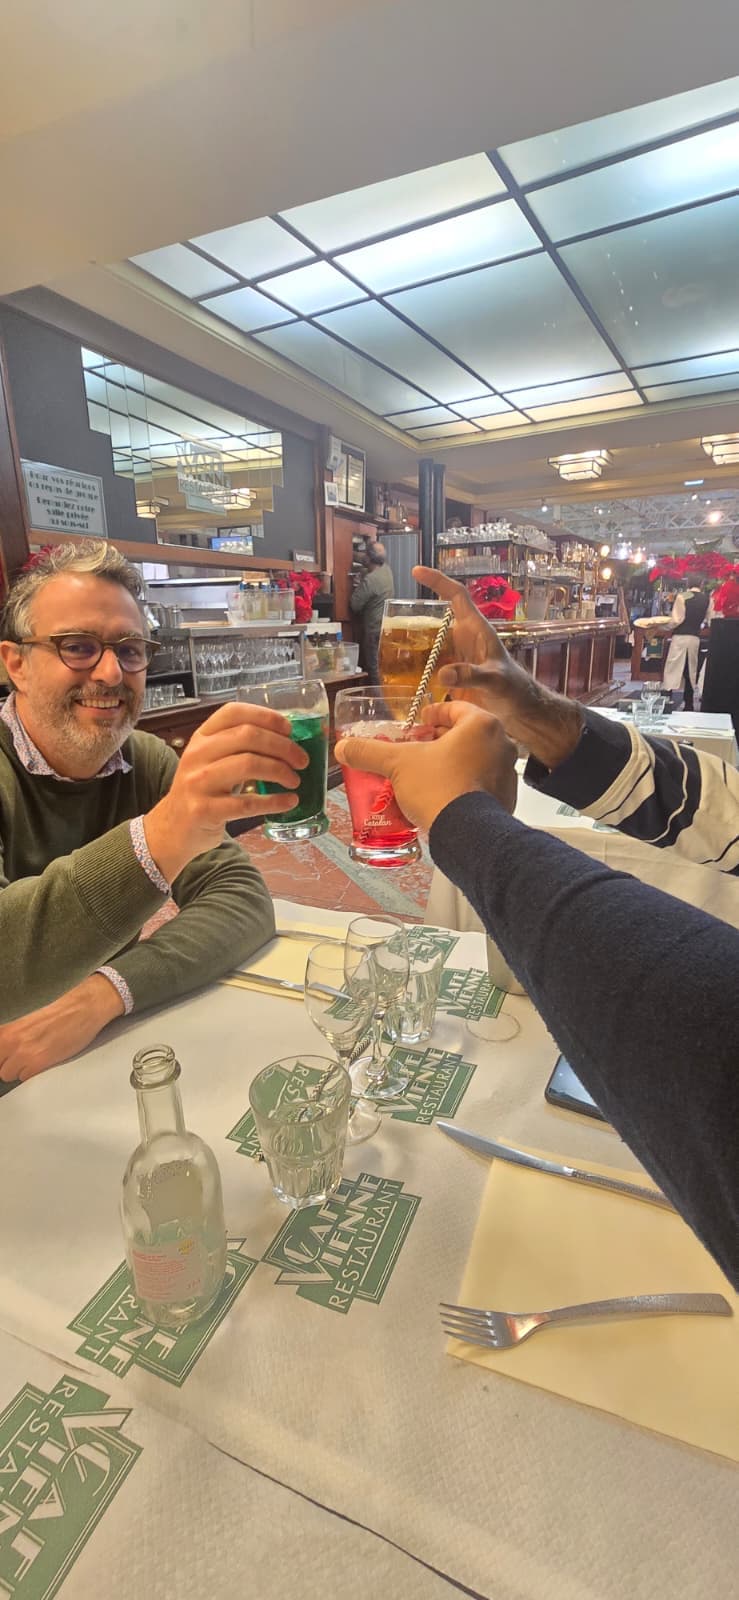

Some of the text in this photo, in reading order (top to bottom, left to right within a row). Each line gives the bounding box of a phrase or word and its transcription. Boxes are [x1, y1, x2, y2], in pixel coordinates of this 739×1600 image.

[416, 1052, 460, 1123] RESTAURANT
[275, 1174, 384, 1285] VIENNE
[283, 1185, 352, 1264] CAFE
[328, 1180, 400, 1309] RESTAURANT
